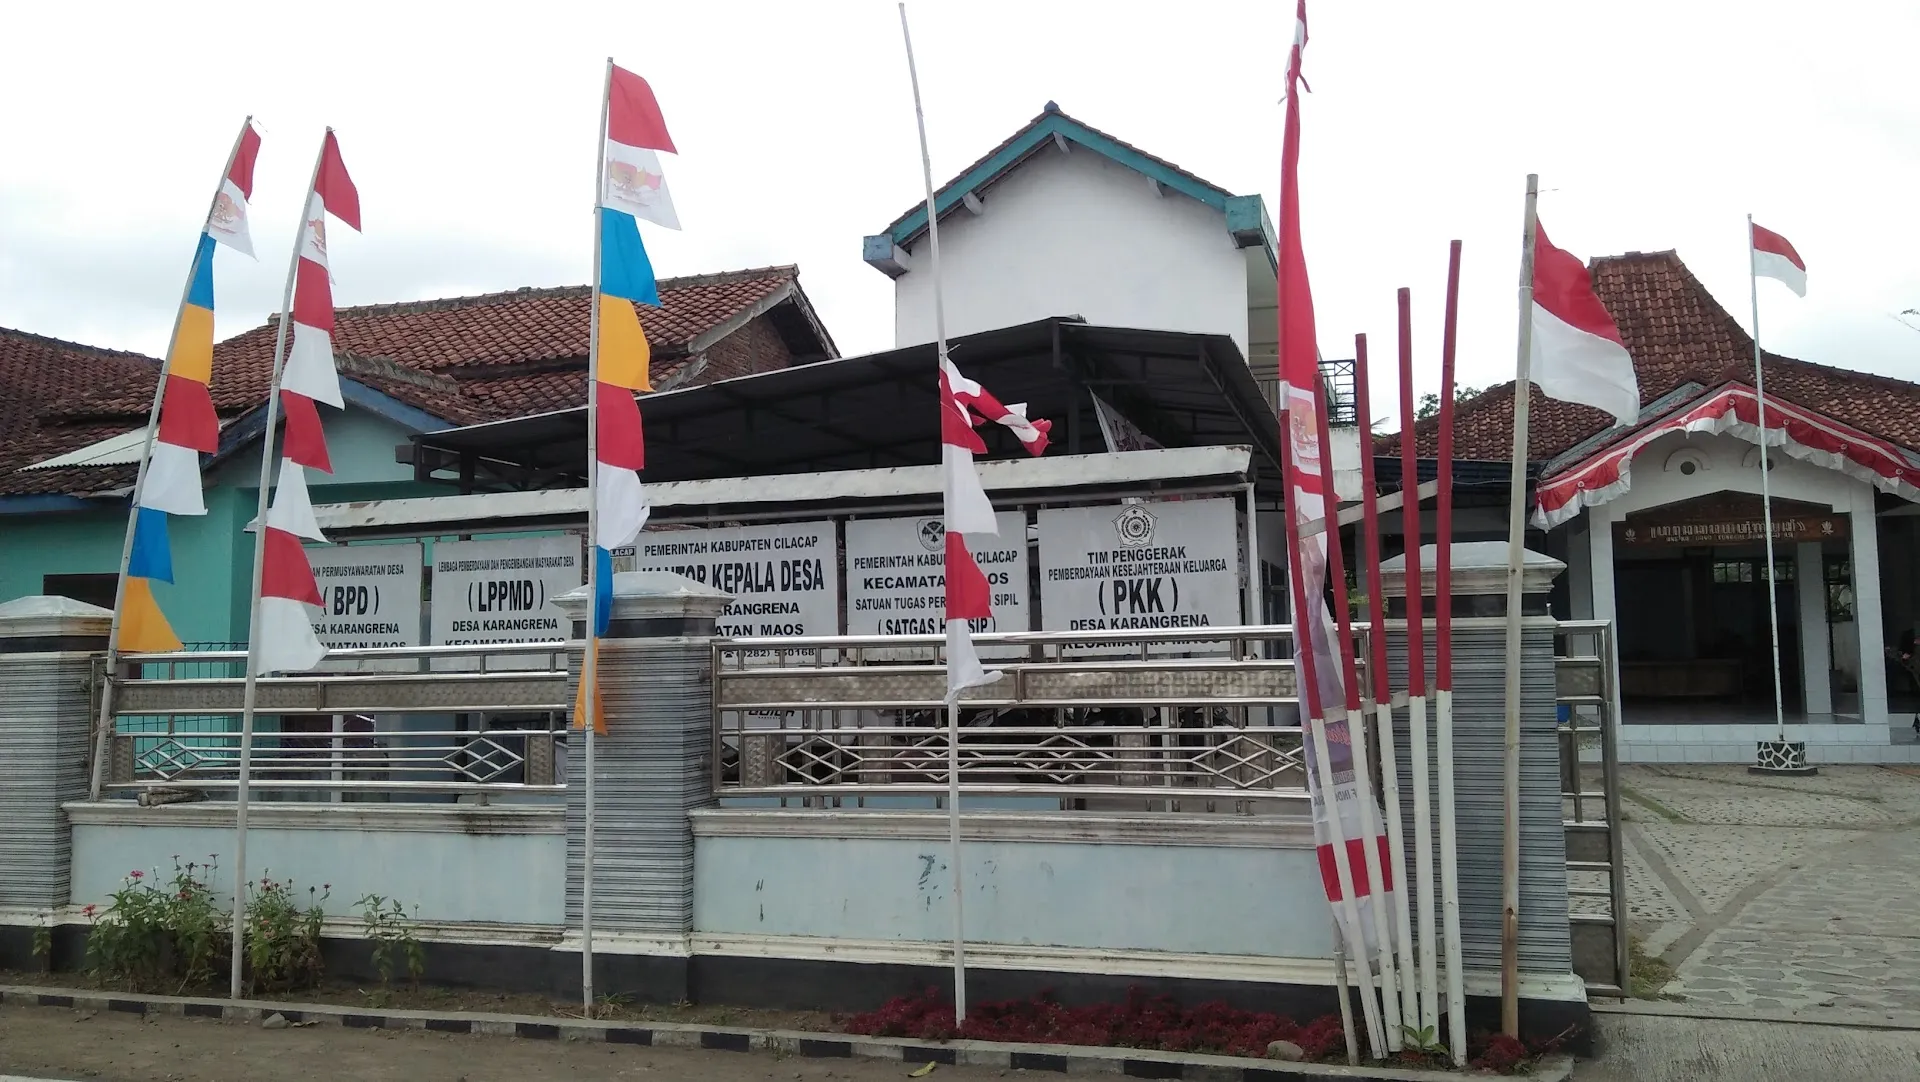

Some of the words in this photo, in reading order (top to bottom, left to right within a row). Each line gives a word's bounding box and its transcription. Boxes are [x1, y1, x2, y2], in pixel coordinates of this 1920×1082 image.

[610, 548, 634, 556] LACAP
[645, 542, 708, 557] PEMERINTAH
[711, 538, 771, 553] KABUPATEN
[774, 536, 818, 550] CILACAP
[439, 561, 458, 572] LEMBAGA
[459, 560, 490, 572] PEMBERDAYAAN
[500, 558, 534, 570] PENGEMBANGAN
[535, 556, 562, 568] MASYARAKAT
[563, 556, 575, 567] DESA
[854, 555, 914, 569] PEMERINTAH
[976, 551, 1018, 563] CILACAP
[1087, 551, 1109, 565] TIM
[1112, 546, 1187, 562] PENGGERAK
[322, 565, 386, 577] PERMUSYAWARATAN
[387, 564, 405, 575] DESA
[712, 561, 775, 594] KEPALA
[781, 559, 825, 592] DESA
[1048, 565, 1110, 581] PEMBERDAYAAN
[1112, 561, 1181, 578] KESEJAHTERAAN
[1183, 558, 1228, 573] KELUARGA
[864, 575, 946, 590] KECAMATA
[988, 572, 1009, 585] OS
[723, 602, 800, 616] RANGRENA
[855, 598, 892, 610] SATUAN
[894, 596, 926, 609] TUGAS
[994, 593, 1019, 606] SIPIL
[330, 623, 400, 634] KARANGRENA
[452, 620, 480, 632] DESA
[483, 618, 558, 631] KARANGRENA
[760, 623, 804, 636] MAOS
[886, 618, 935, 635] SATGAS
[940, 617, 988, 634] HSIP
[1070, 619, 1106, 631] DESA
[1110, 614, 1210, 630] KARANGRENA
